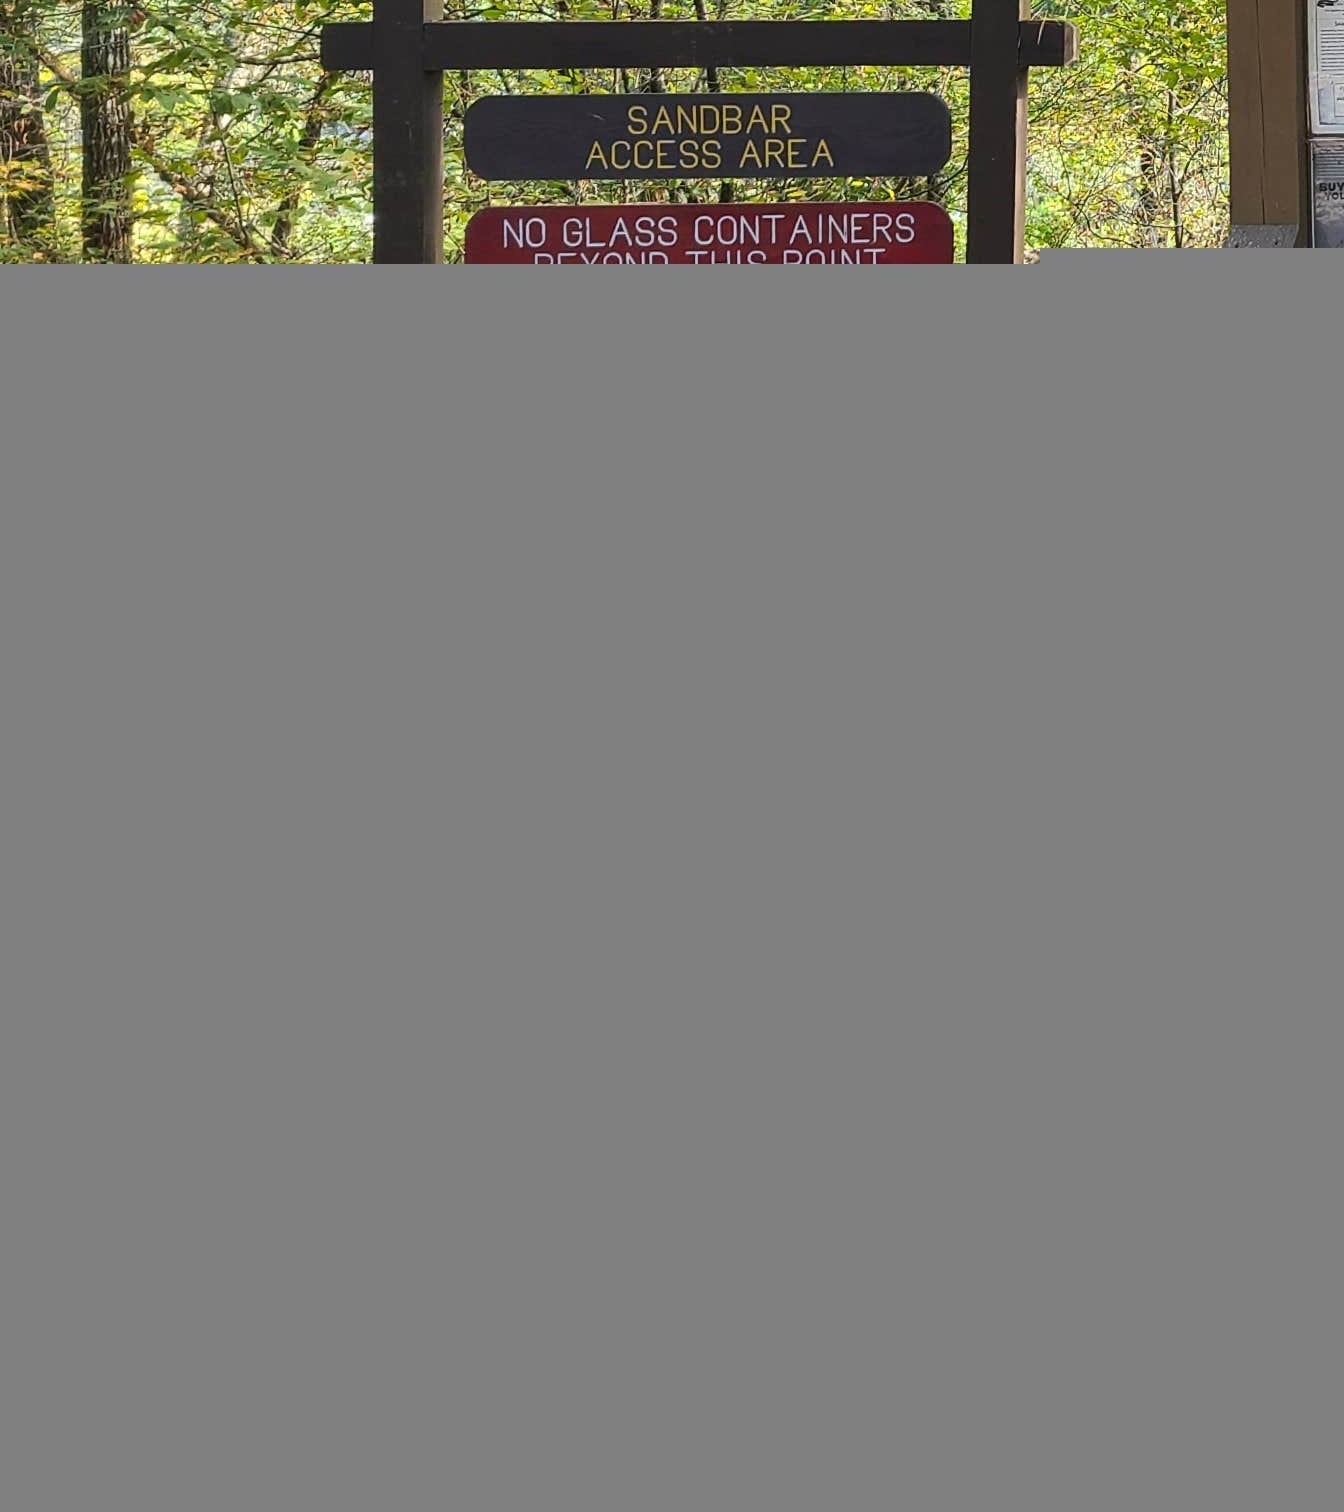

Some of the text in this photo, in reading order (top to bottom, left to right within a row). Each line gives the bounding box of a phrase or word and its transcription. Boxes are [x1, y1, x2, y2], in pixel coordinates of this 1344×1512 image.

[627, 104, 792, 135] SANDBAR
[585, 139, 834, 170] ACCESS AREA
[503, 213, 915, 249] NO GLASS CONTAINERS
